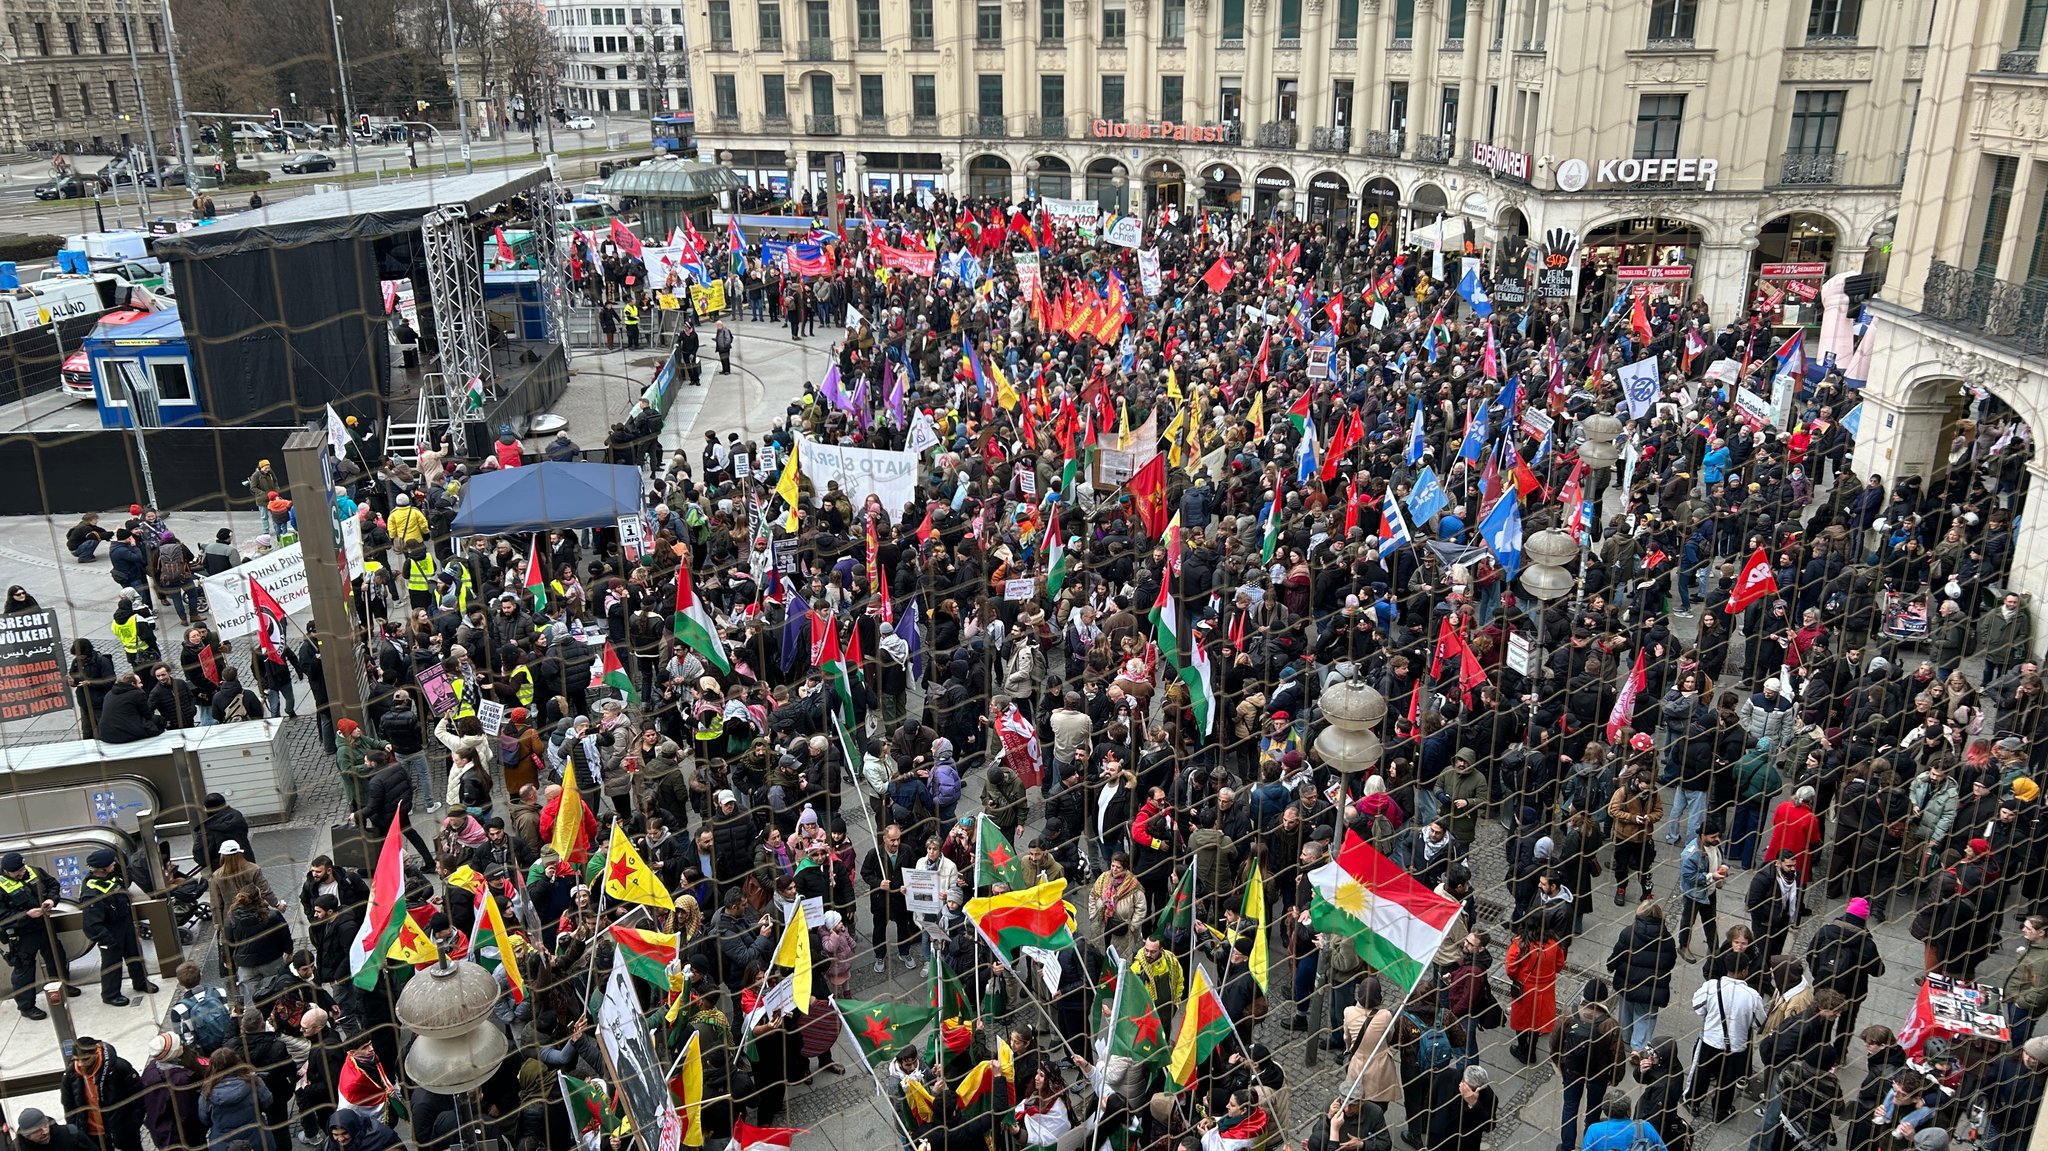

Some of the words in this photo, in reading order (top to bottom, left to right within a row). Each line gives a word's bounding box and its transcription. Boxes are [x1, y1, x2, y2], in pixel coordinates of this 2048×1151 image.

[1092, 119, 1224, 143] Gloria-Palast
[1473, 141, 1529, 178] LEDERWAREN
[836, 162, 843, 174] U
[1597, 159, 1718, 191] KOFFER
[837, 177, 844, 192] S
[1257, 177, 1290, 187] STARBUCKS
[1314, 181, 1340, 190] reisebank
[1072, 205, 1096, 214] PEACE
[1119, 222, 1135, 232] pax
[1113, 231, 1137, 242] christi
[1547, 254, 1568, 267] STOP
[1548, 269, 1564, 277] KEIN
[1647, 268, 1664, 277] 70%
[1540, 277, 1570, 285] WERBEN
[1538, 288, 1570, 297] STERBEN
[322, 453, 331, 492] U
[331, 505, 341, 545] S
[250, 562, 279, 581] OHNE
[280, 552, 304, 568] PRIN
[0, 683, 64, 704] ASCHINERIE
[2, 703, 28, 719] DER
[31, 695, 68, 714] NATO!
[483, 704, 500, 714] GEGEN
[480, 709, 488, 717] DIE
[488, 712, 500, 720] NATO
